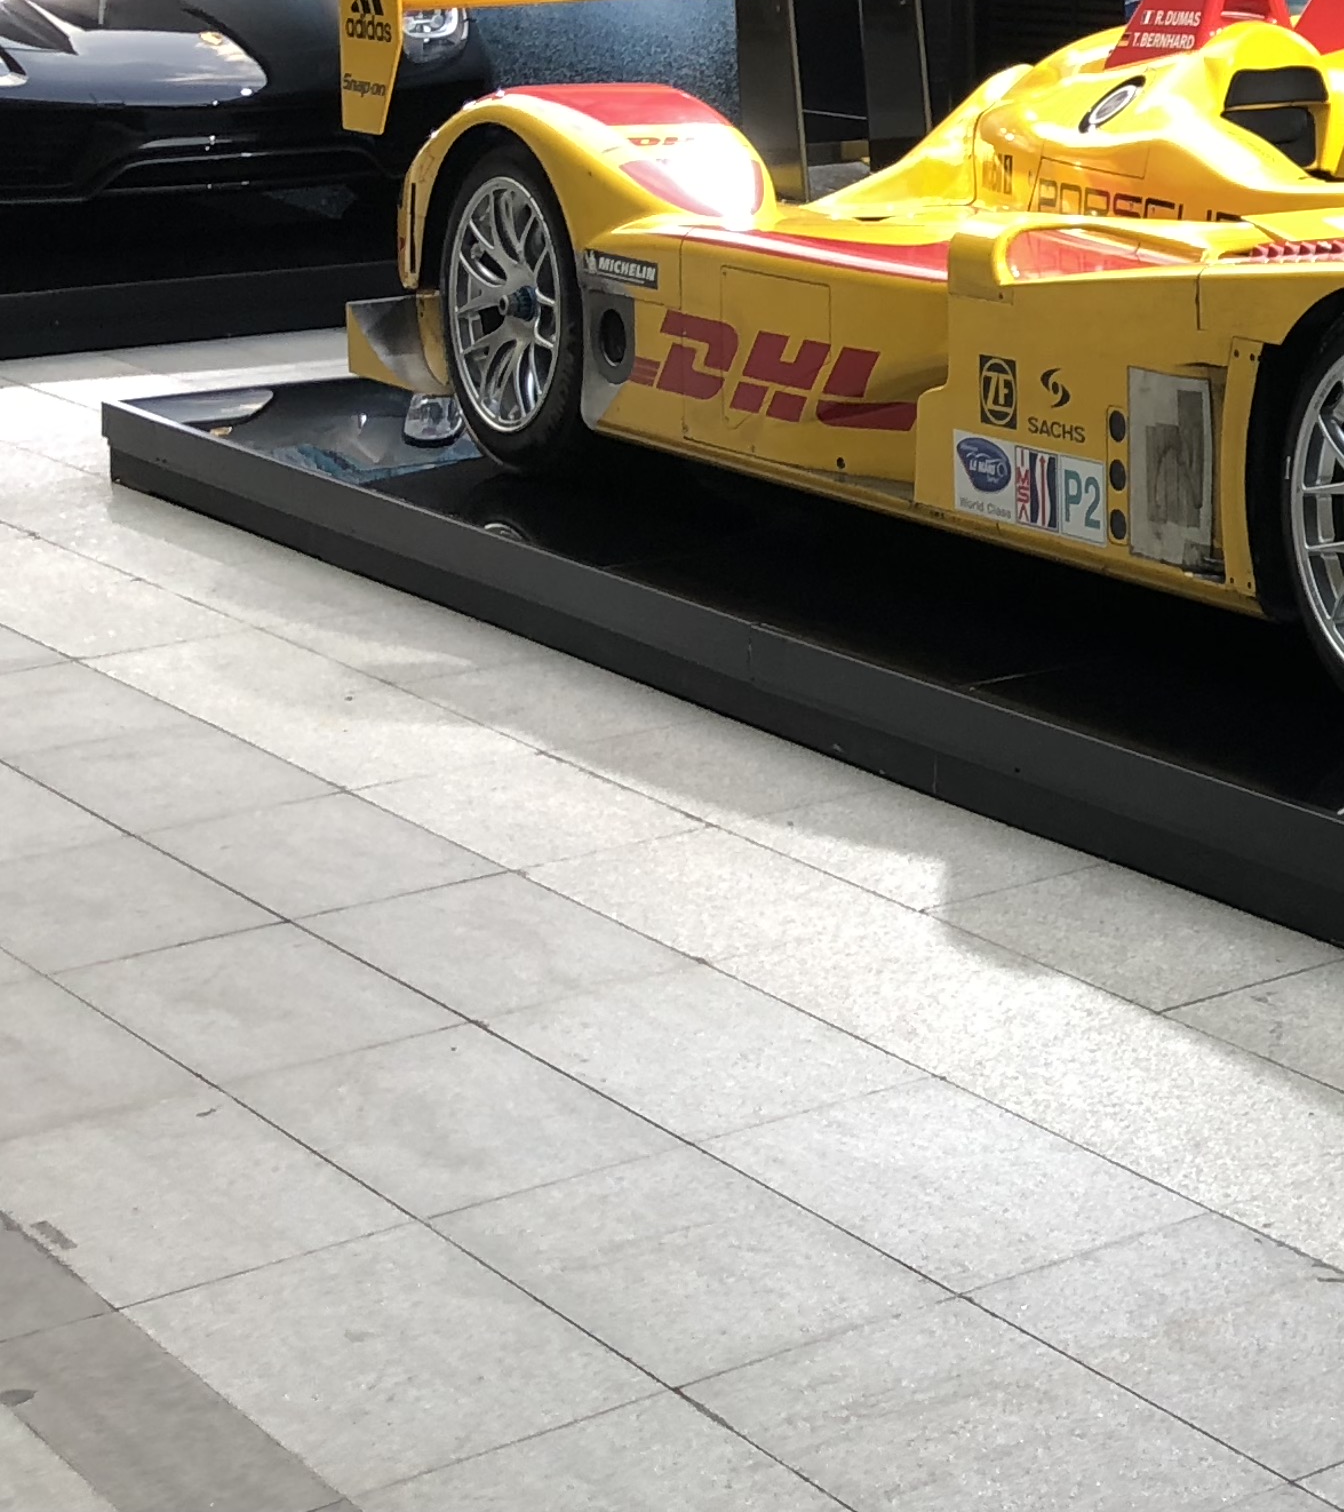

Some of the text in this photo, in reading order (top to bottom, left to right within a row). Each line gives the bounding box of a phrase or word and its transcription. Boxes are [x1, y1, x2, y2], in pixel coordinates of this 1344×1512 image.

[345, 14, 392, 43] adidas
[342, 73, 386, 98] Snap-on
[1038, 176, 1242, 223] PORSC
[599, 256, 656, 281] MICHELIN
[656, 309, 917, 431] DHL
[983, 371, 1014, 414] ZF
[1027, 416, 1086, 443] SACHS
[1016, 449, 1031, 522] IMSA
[1064, 469, 1101, 530] P2
[960, 497, 984, 512] World
